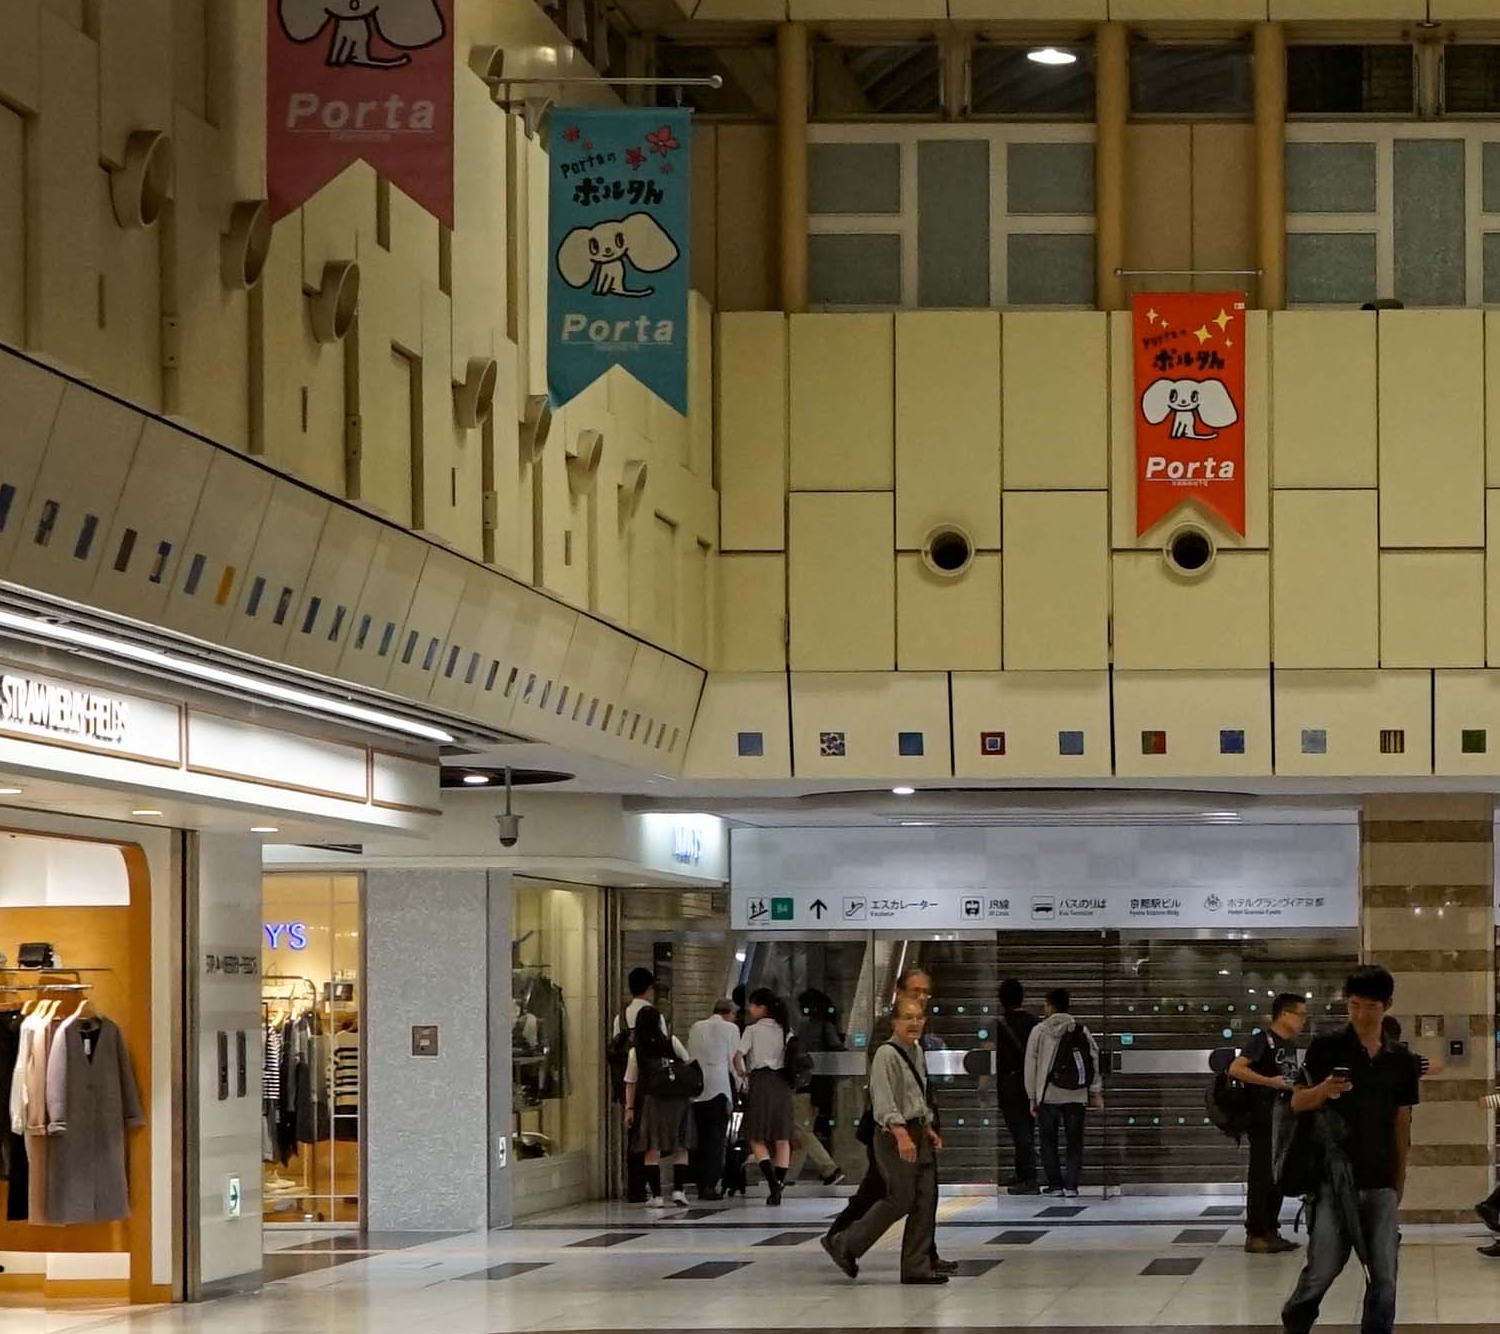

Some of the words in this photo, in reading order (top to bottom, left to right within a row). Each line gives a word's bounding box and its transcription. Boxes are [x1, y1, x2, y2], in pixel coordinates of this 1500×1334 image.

[287, 93, 435, 129] Porta
[572, 176, 664, 206] ポルタん
[561, 313, 673, 343] Porta
[1145, 456, 1235, 480] Porta
